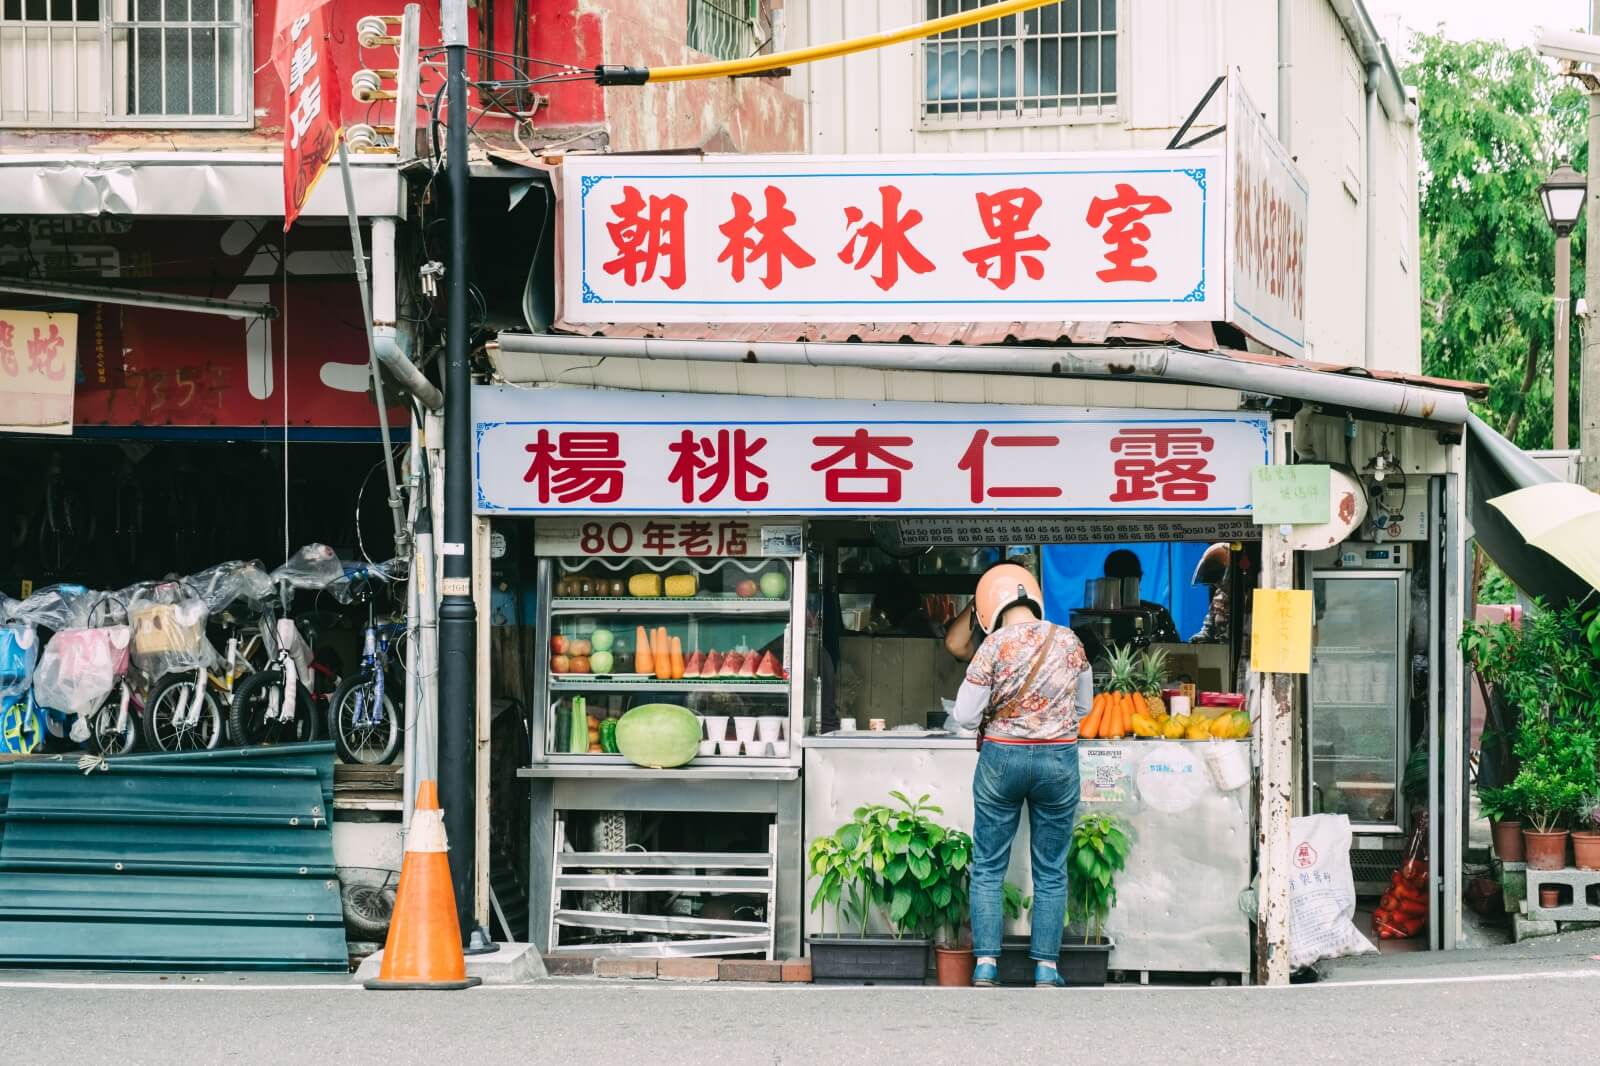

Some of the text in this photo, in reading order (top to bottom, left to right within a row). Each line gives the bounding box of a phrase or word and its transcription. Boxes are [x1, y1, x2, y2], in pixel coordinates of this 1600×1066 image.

[603, 183, 1173, 291] 朝林冰果室
[524, 428, 1216, 504] 楊桃杏仁露
[580, 520, 749, 557] 80年老店
[1232, 530, 1243, 538] 30
